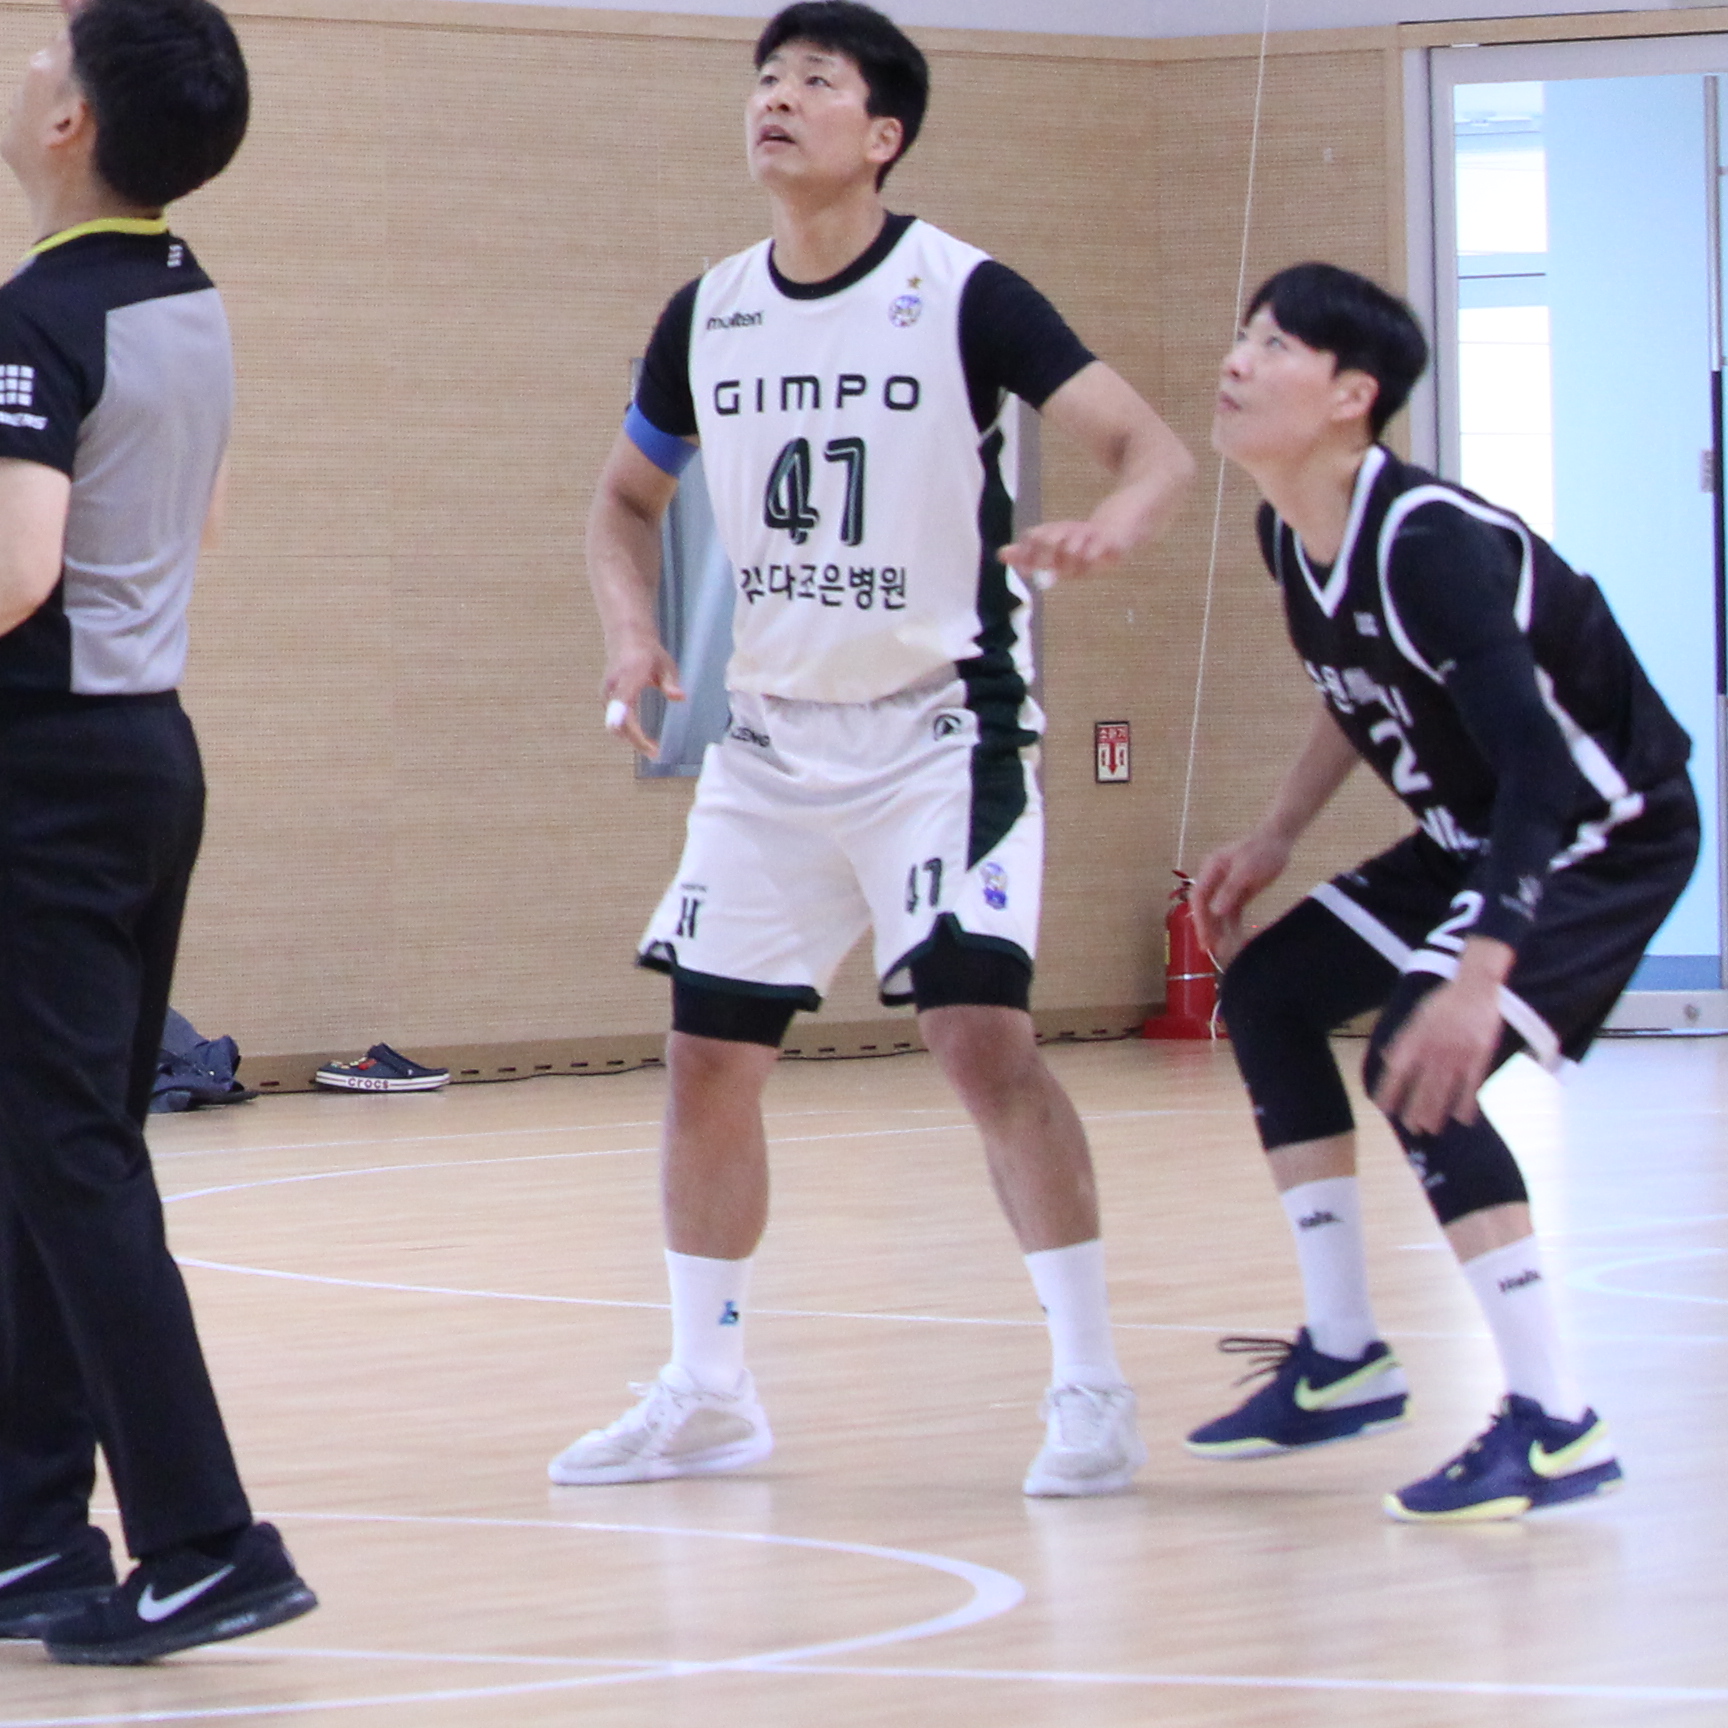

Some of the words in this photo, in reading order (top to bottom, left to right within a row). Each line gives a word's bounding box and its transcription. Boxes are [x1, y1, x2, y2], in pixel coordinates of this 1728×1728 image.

[713, 373, 921, 417] GIMPO
[1369, 718, 1433, 794] 2
[1425, 889, 1486, 953] 2
